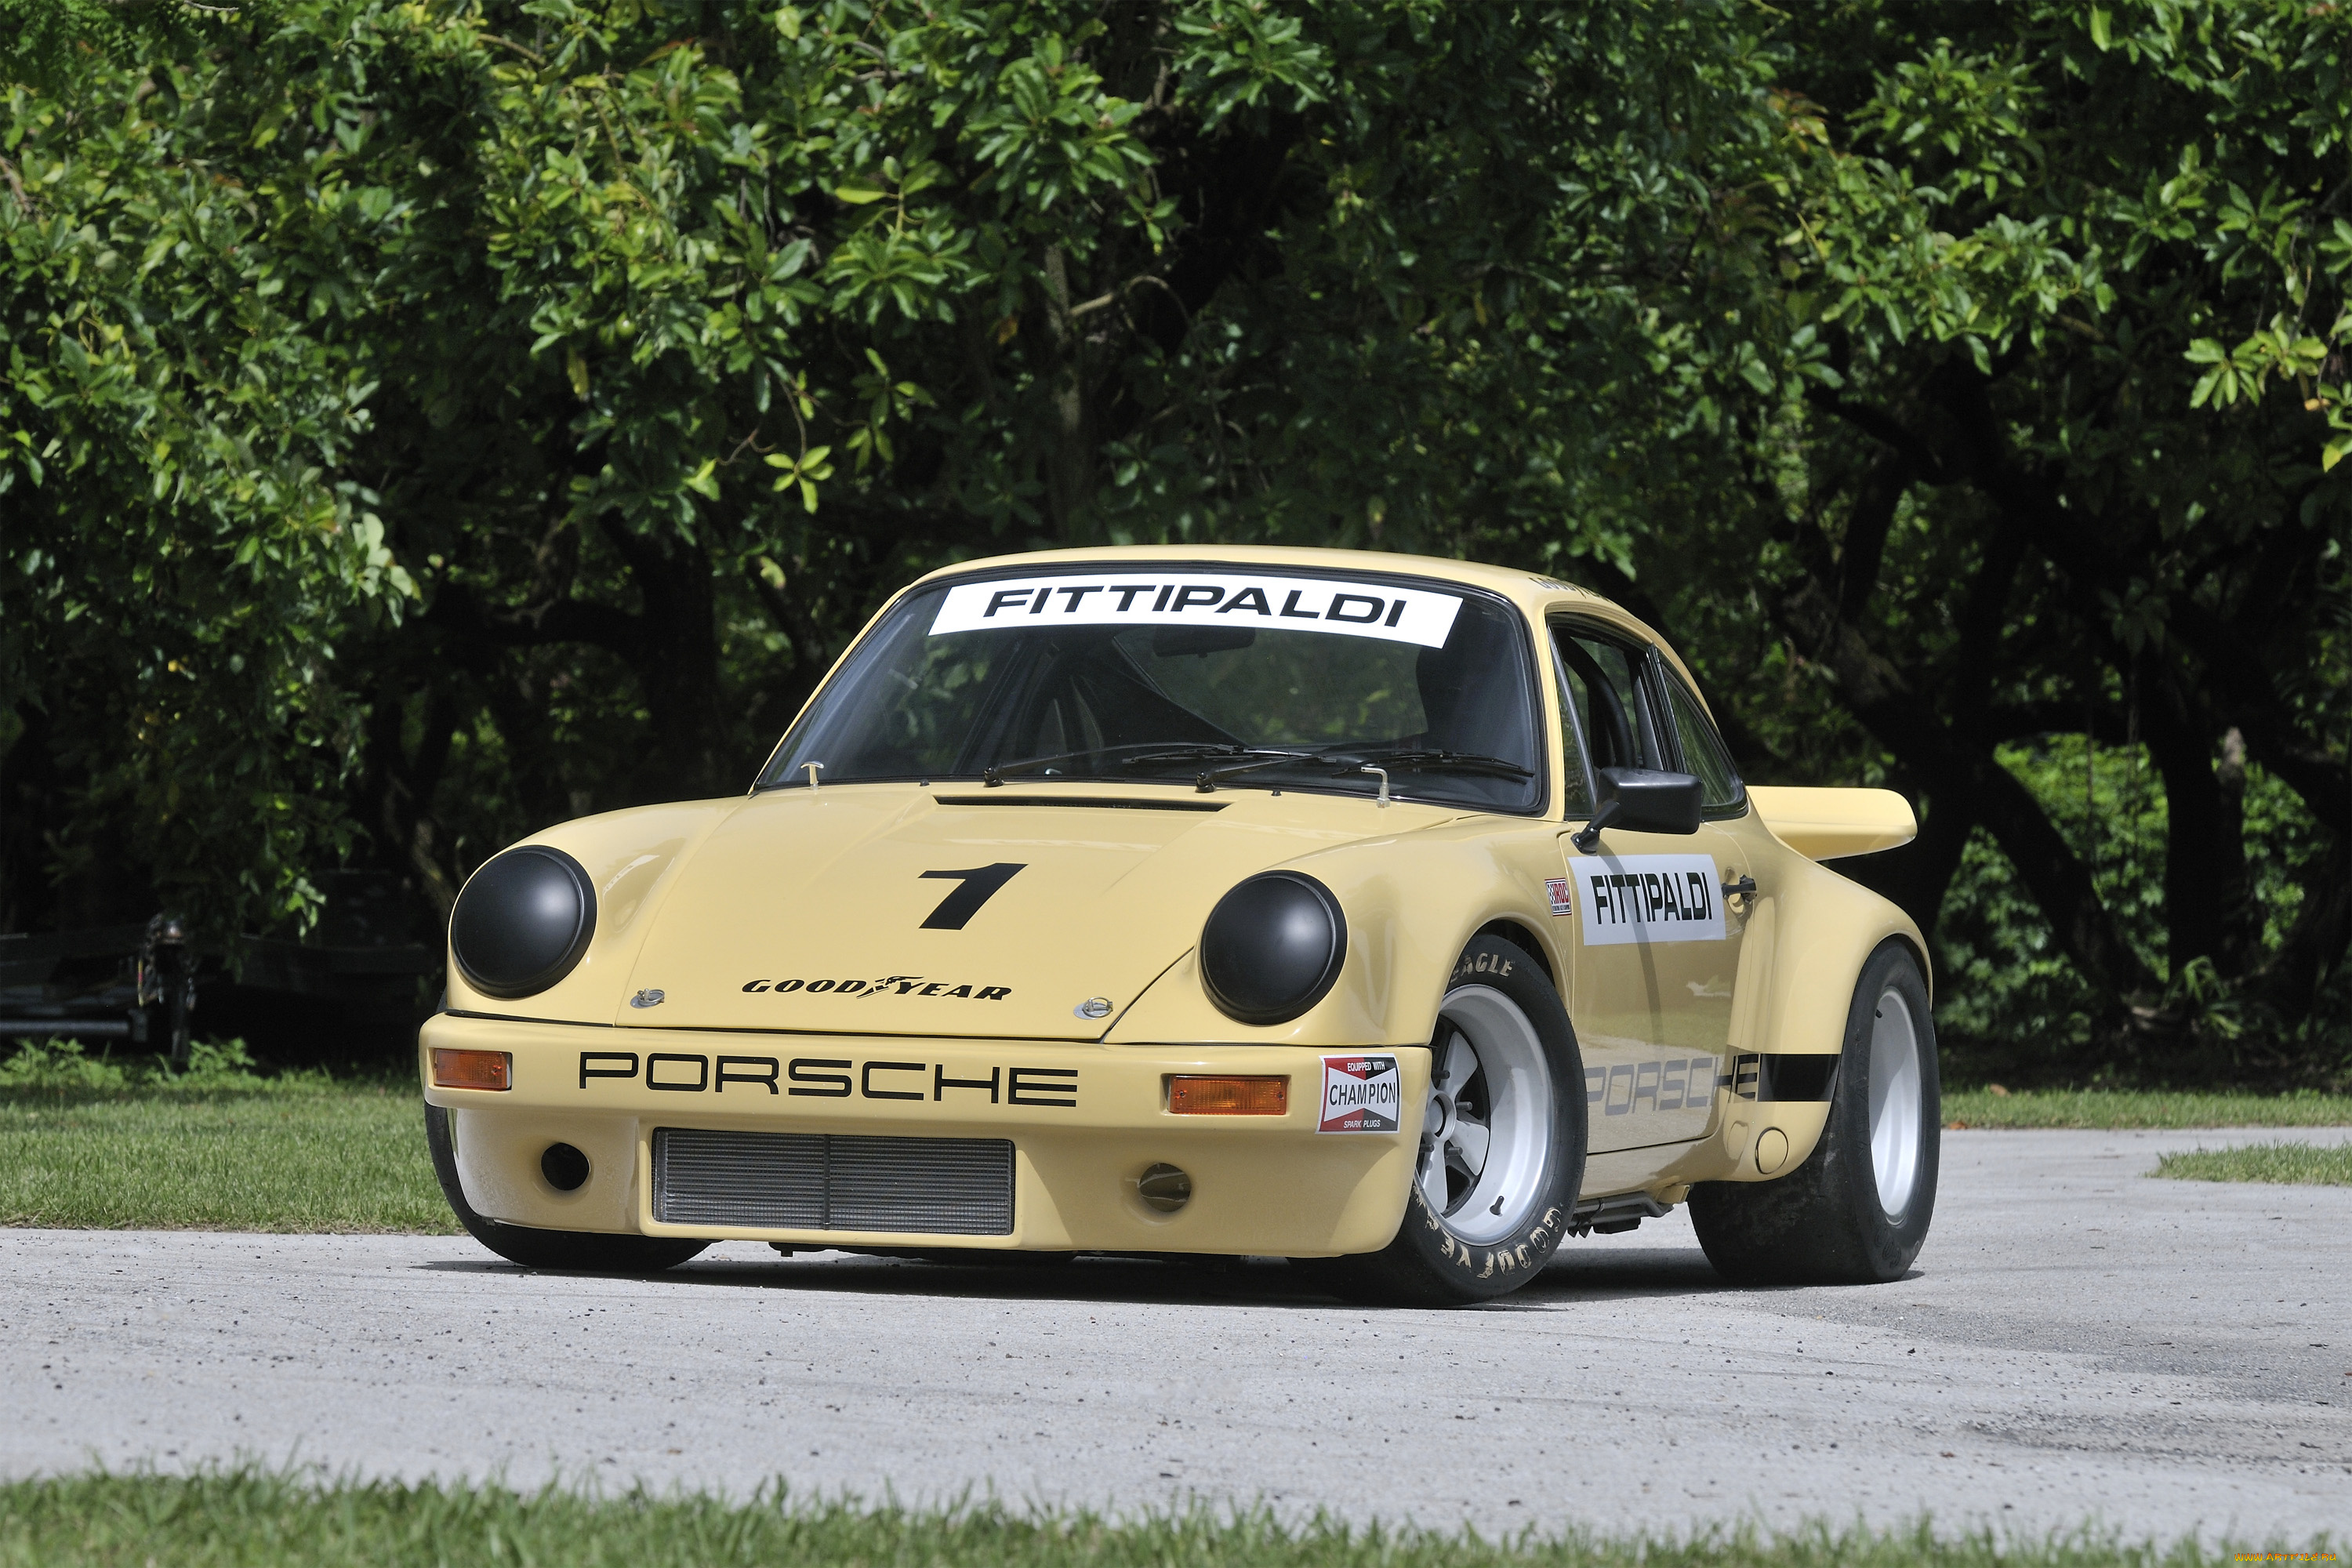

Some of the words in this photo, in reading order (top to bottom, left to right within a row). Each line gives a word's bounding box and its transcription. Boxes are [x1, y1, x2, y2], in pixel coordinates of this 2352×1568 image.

[982, 584, 1406, 628] FITTIPALDI
[917, 862, 1029, 931] 1
[1590, 872, 1712, 924] FITTIPALDI
[741, 976, 1012, 1001] GOODYEAR
[579, 1051, 1078, 1107] PORSCHE
[1347, 1062, 1371, 1072] EQUIPPED
[1373, 1061, 1385, 1071] WITH
[1584, 1053, 1759, 1116] PORSCHE
[1329, 1082, 1396, 1105] CHAMPION
